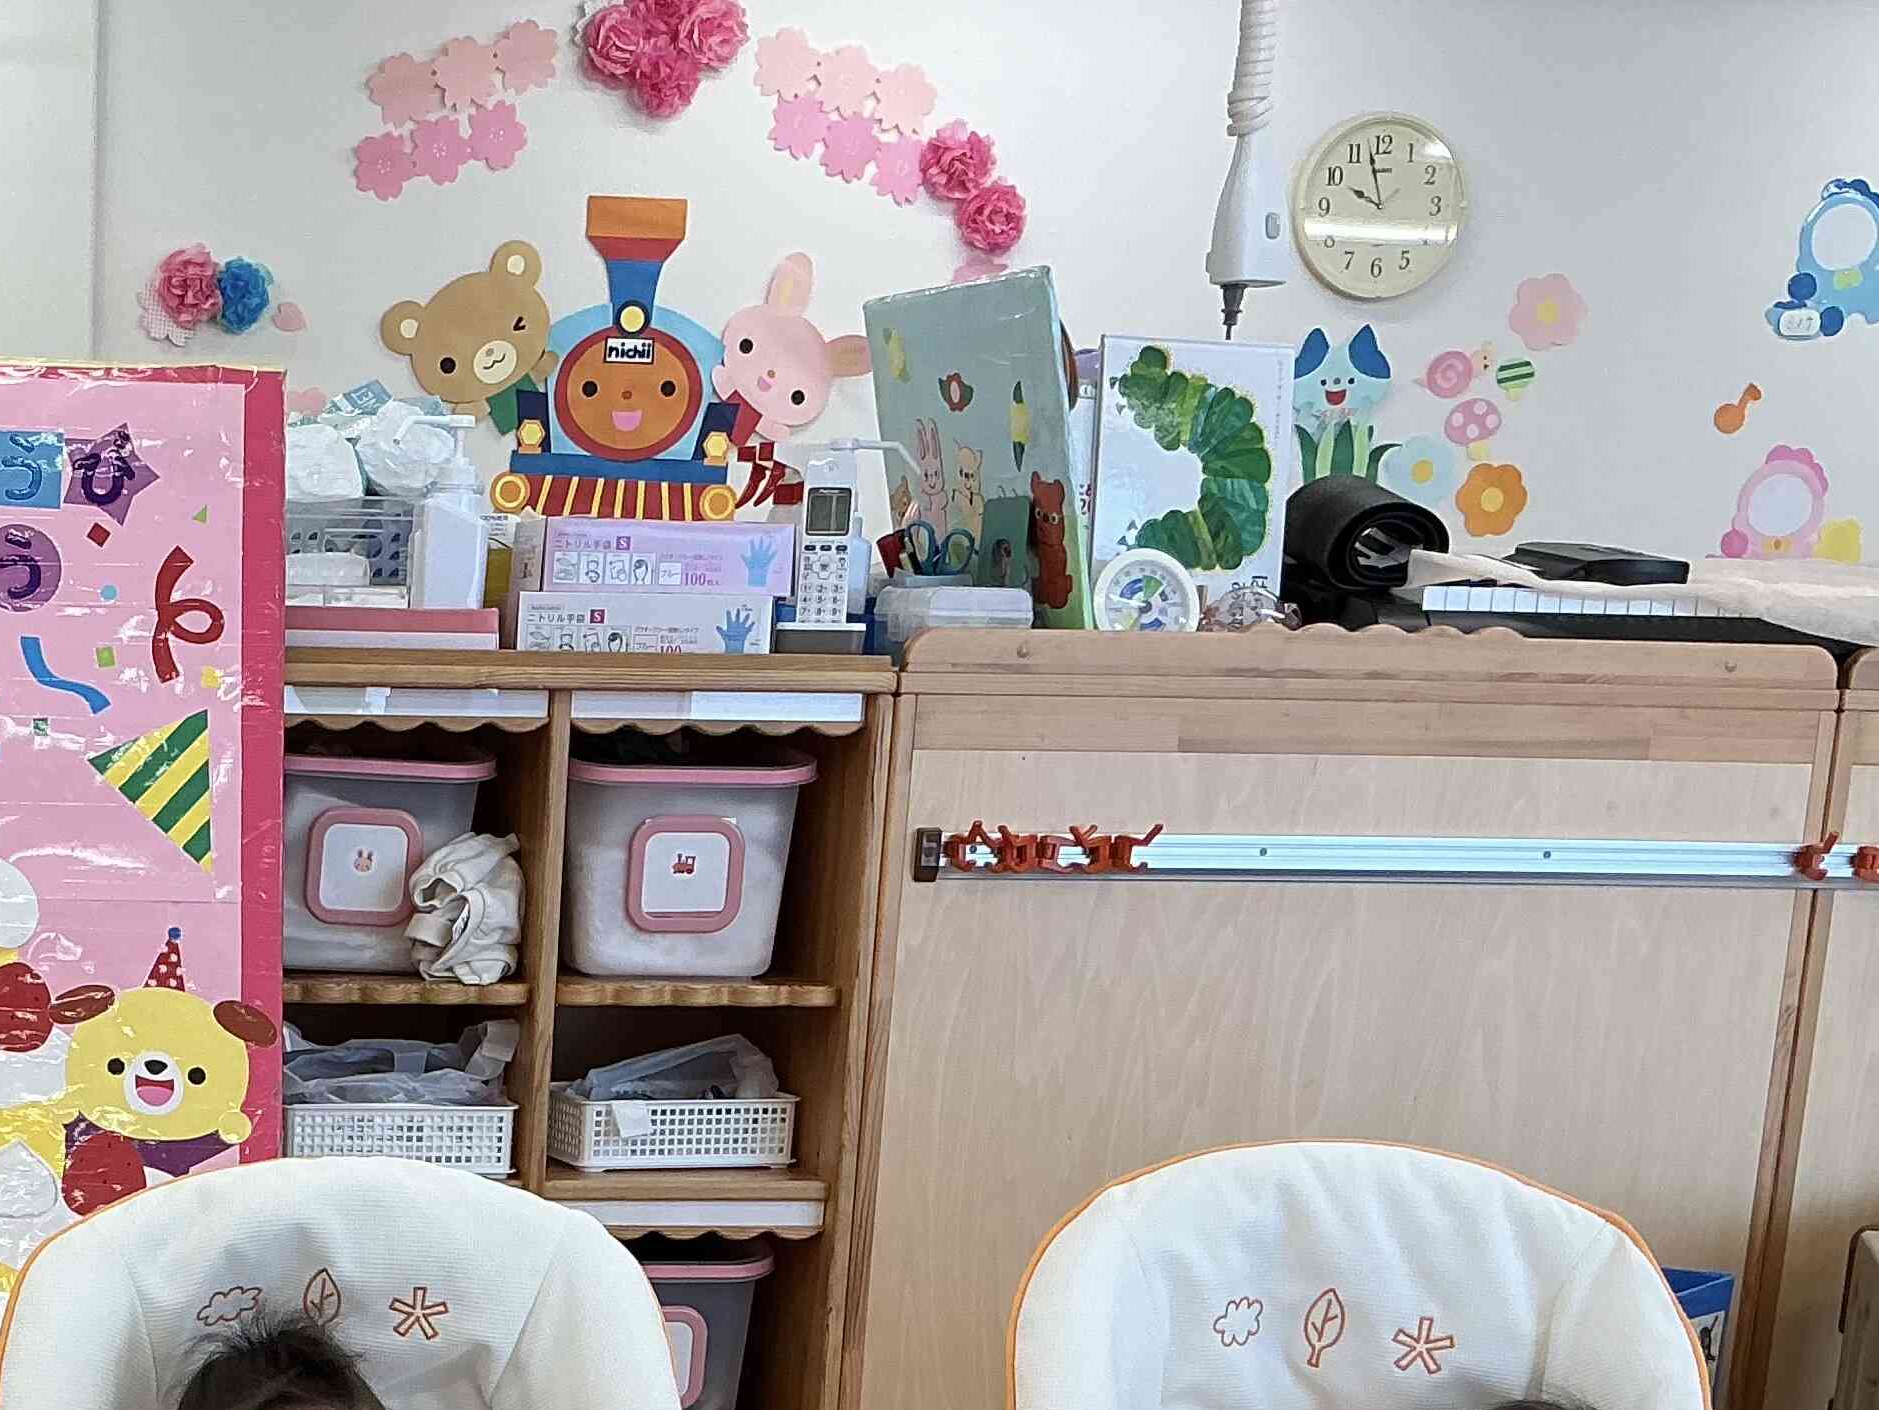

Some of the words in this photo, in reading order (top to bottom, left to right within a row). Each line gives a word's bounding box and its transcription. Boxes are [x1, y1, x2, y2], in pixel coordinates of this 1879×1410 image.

[1347, 143, 1362, 164] 11
[1374, 134, 1394, 155] 12
[1406, 143, 1415, 163] 1
[1325, 165, 1344, 186] 10
[1424, 164, 1438, 185] 2
[1318, 196, 1331, 217] 9
[1428, 195, 1442, 216] 3
[1343, 250, 1355, 270] 7
[1370, 257, 1383, 278] 6
[1398, 250, 1411, 270] 5
[608, 341, 651, 359] nichii
